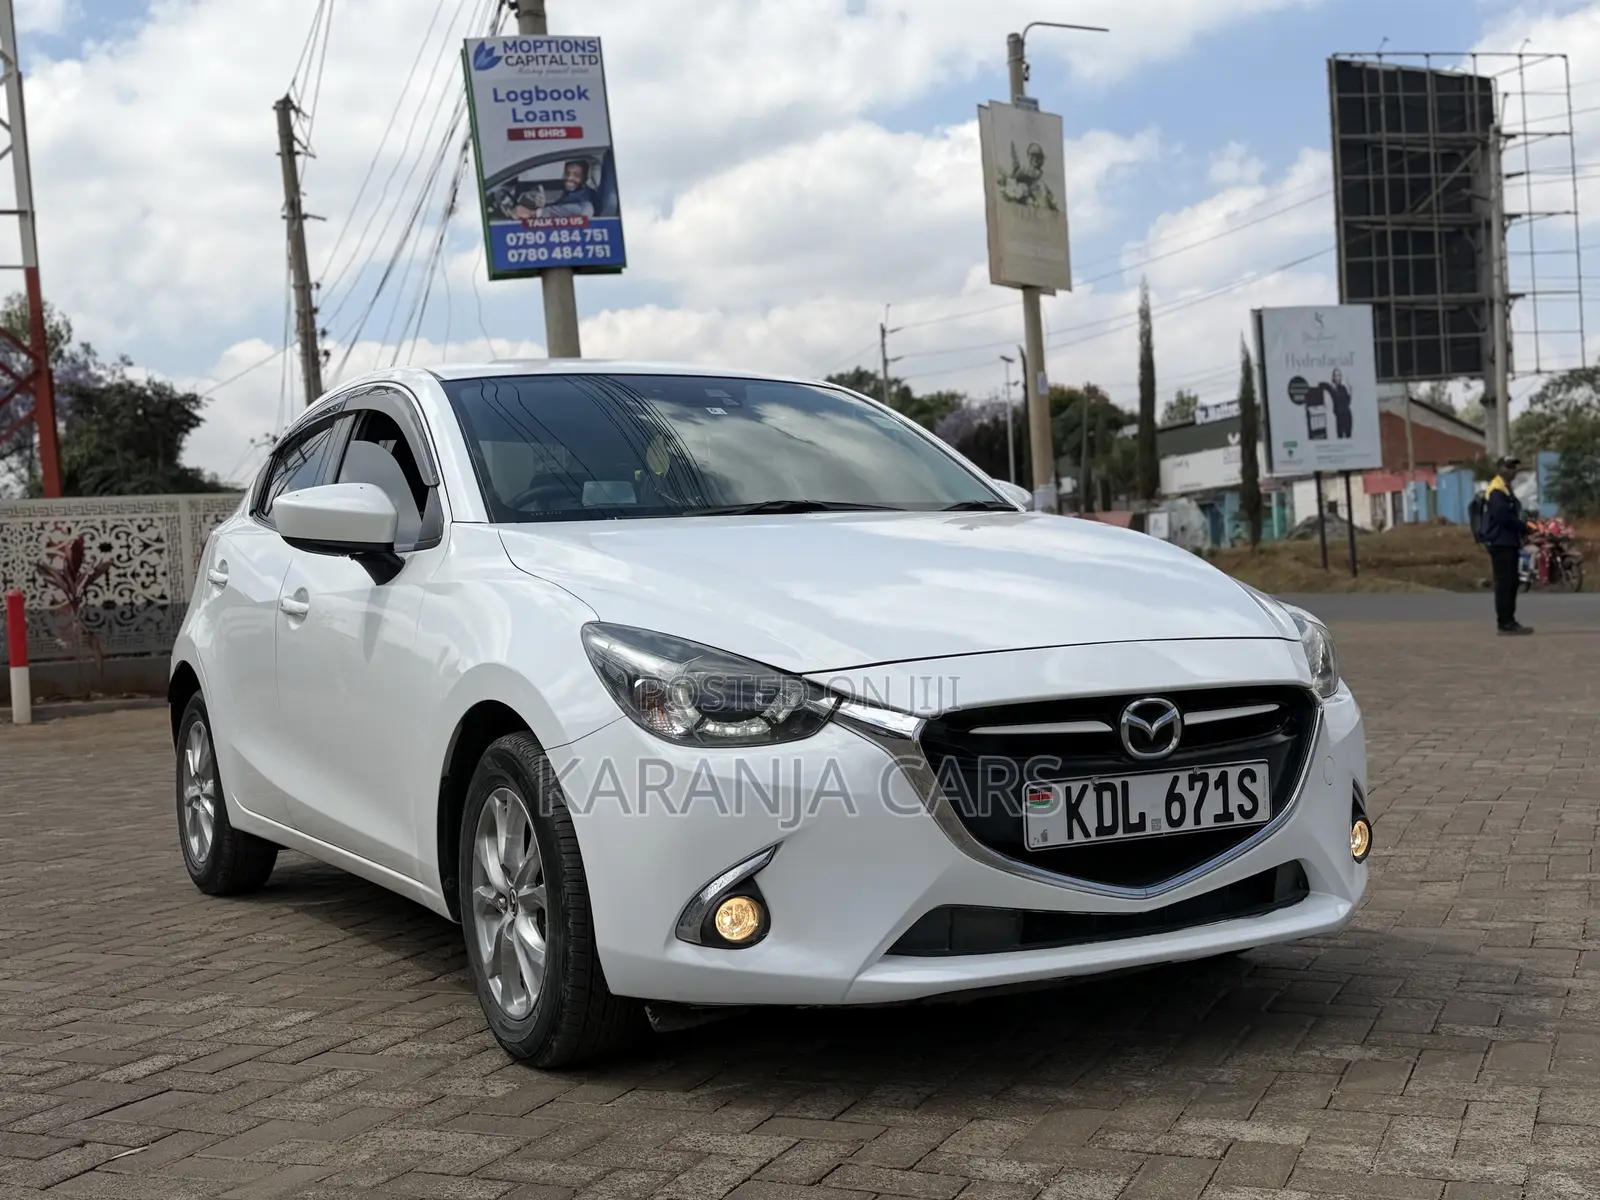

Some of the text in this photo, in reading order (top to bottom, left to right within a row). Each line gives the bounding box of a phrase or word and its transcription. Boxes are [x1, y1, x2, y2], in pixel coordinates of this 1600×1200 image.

[503, 40, 597, 53] MOPTIONS
[505, 54, 599, 66] CAPITAL LTD
[493, 85, 590, 105] Logbook
[512, 108, 577, 123] Loans
[523, 128, 566, 138] IN 6HRS
[527, 217, 583, 227] TALK TO US
[506, 229, 608, 246] 0790 484 751
[508, 245, 611, 262] 0780 484 751
[1064, 780, 1147, 840] KDL
[1164, 767, 1259, 829] 671S
